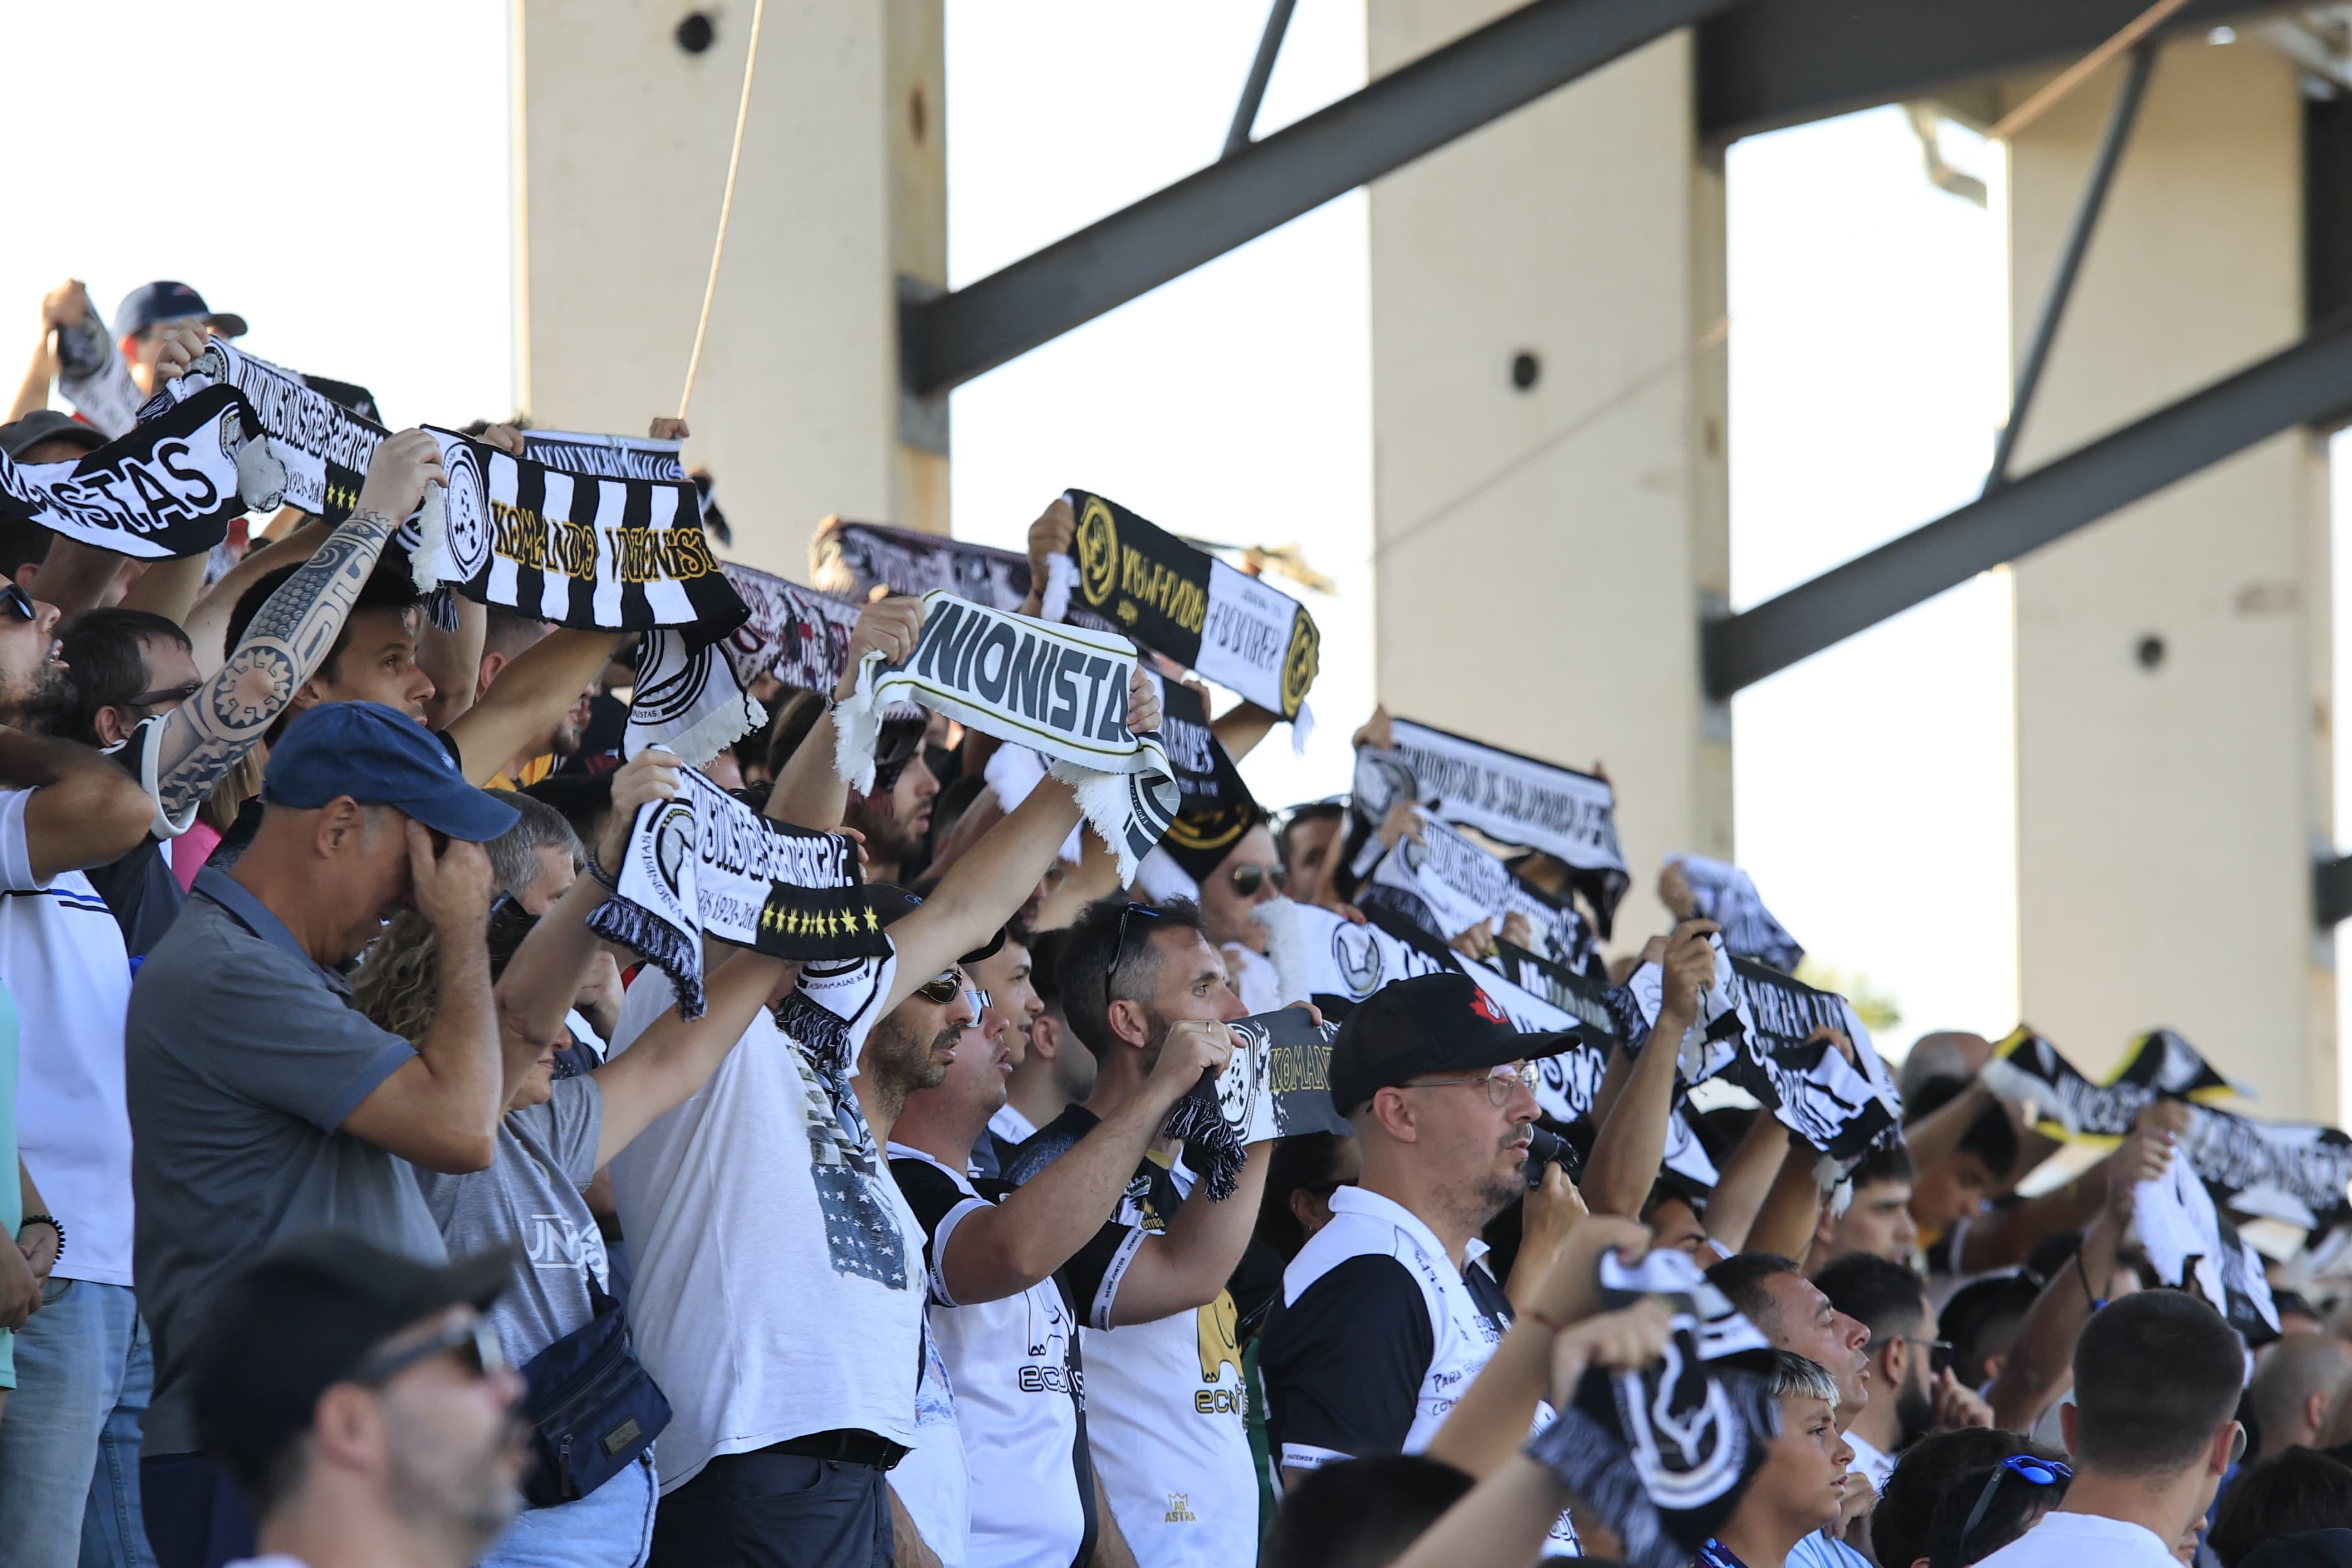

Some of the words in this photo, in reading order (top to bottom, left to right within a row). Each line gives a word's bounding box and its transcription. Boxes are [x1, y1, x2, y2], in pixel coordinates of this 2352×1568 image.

[491, 499, 597, 581] KOMANDO
[1111, 1257, 1126, 1281] JUNTOS
[1165, 1511, 1197, 1523] ASTRA
